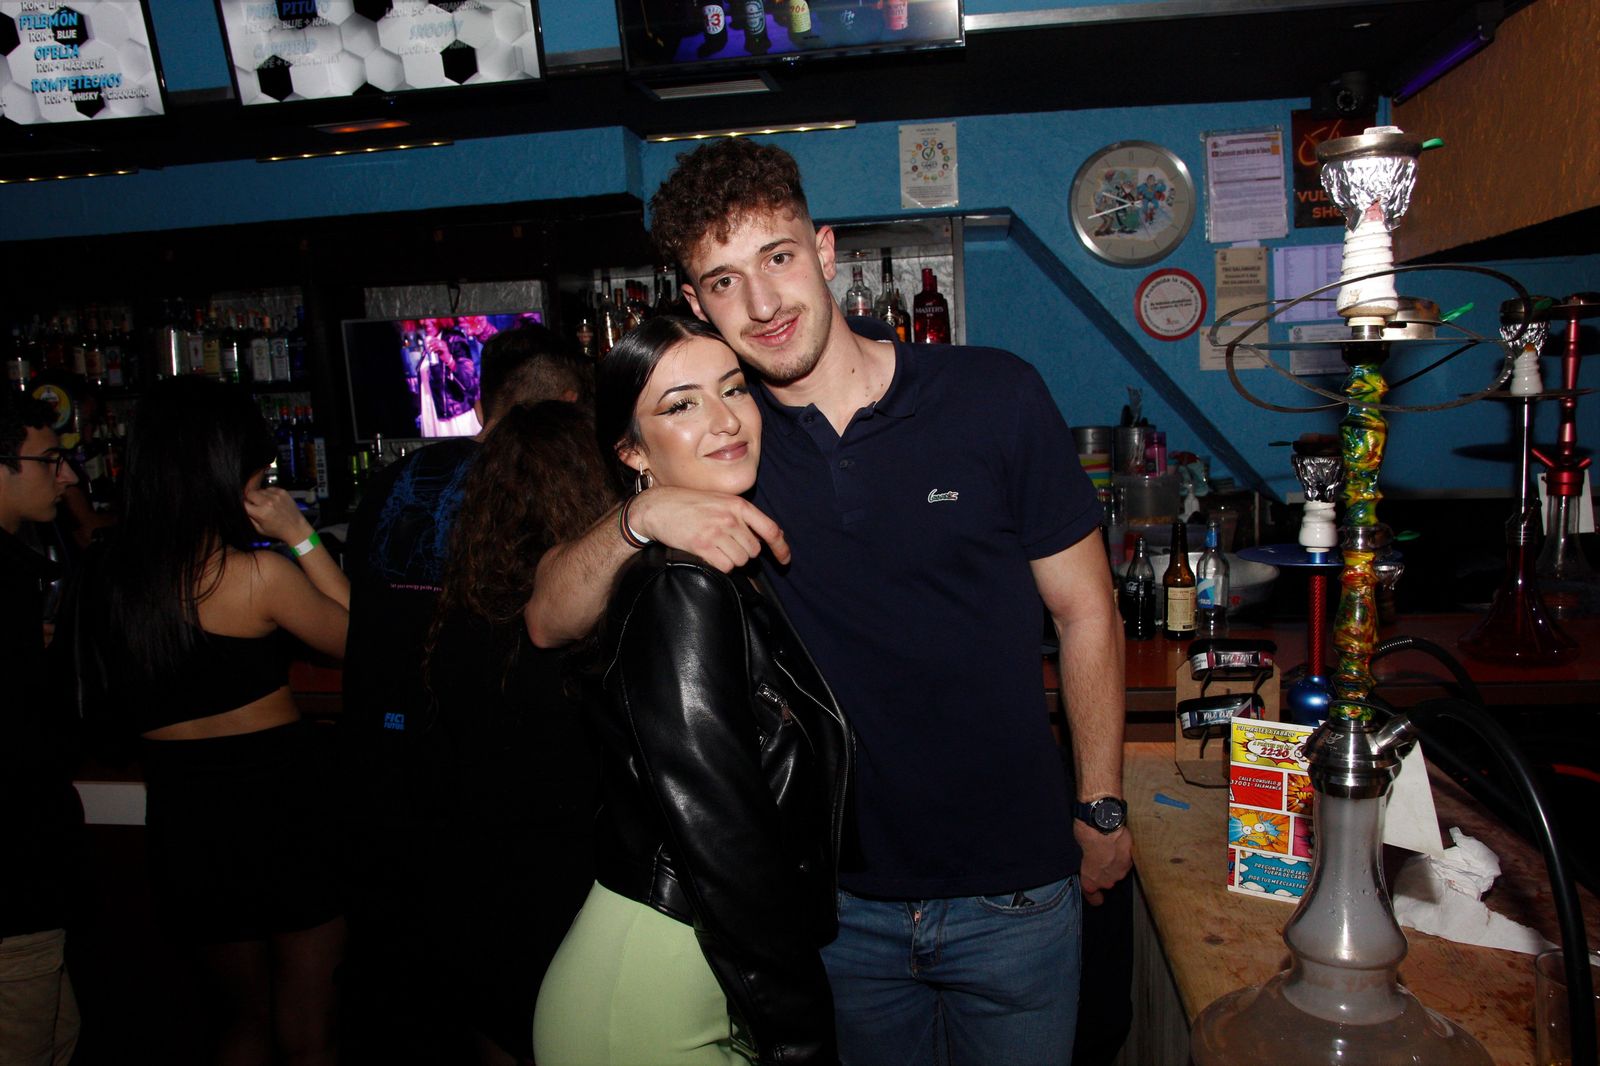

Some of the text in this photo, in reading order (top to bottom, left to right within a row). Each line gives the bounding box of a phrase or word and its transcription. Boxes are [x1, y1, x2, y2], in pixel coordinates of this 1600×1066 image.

[19, 11, 78, 30] FILEMÓN
[56, 29, 77, 39] BLUE
[34, 44, 80, 61] OFELIA
[31, 74, 123, 94] ROMPETECHOS
[70, 91, 99, 102] WHISKY
